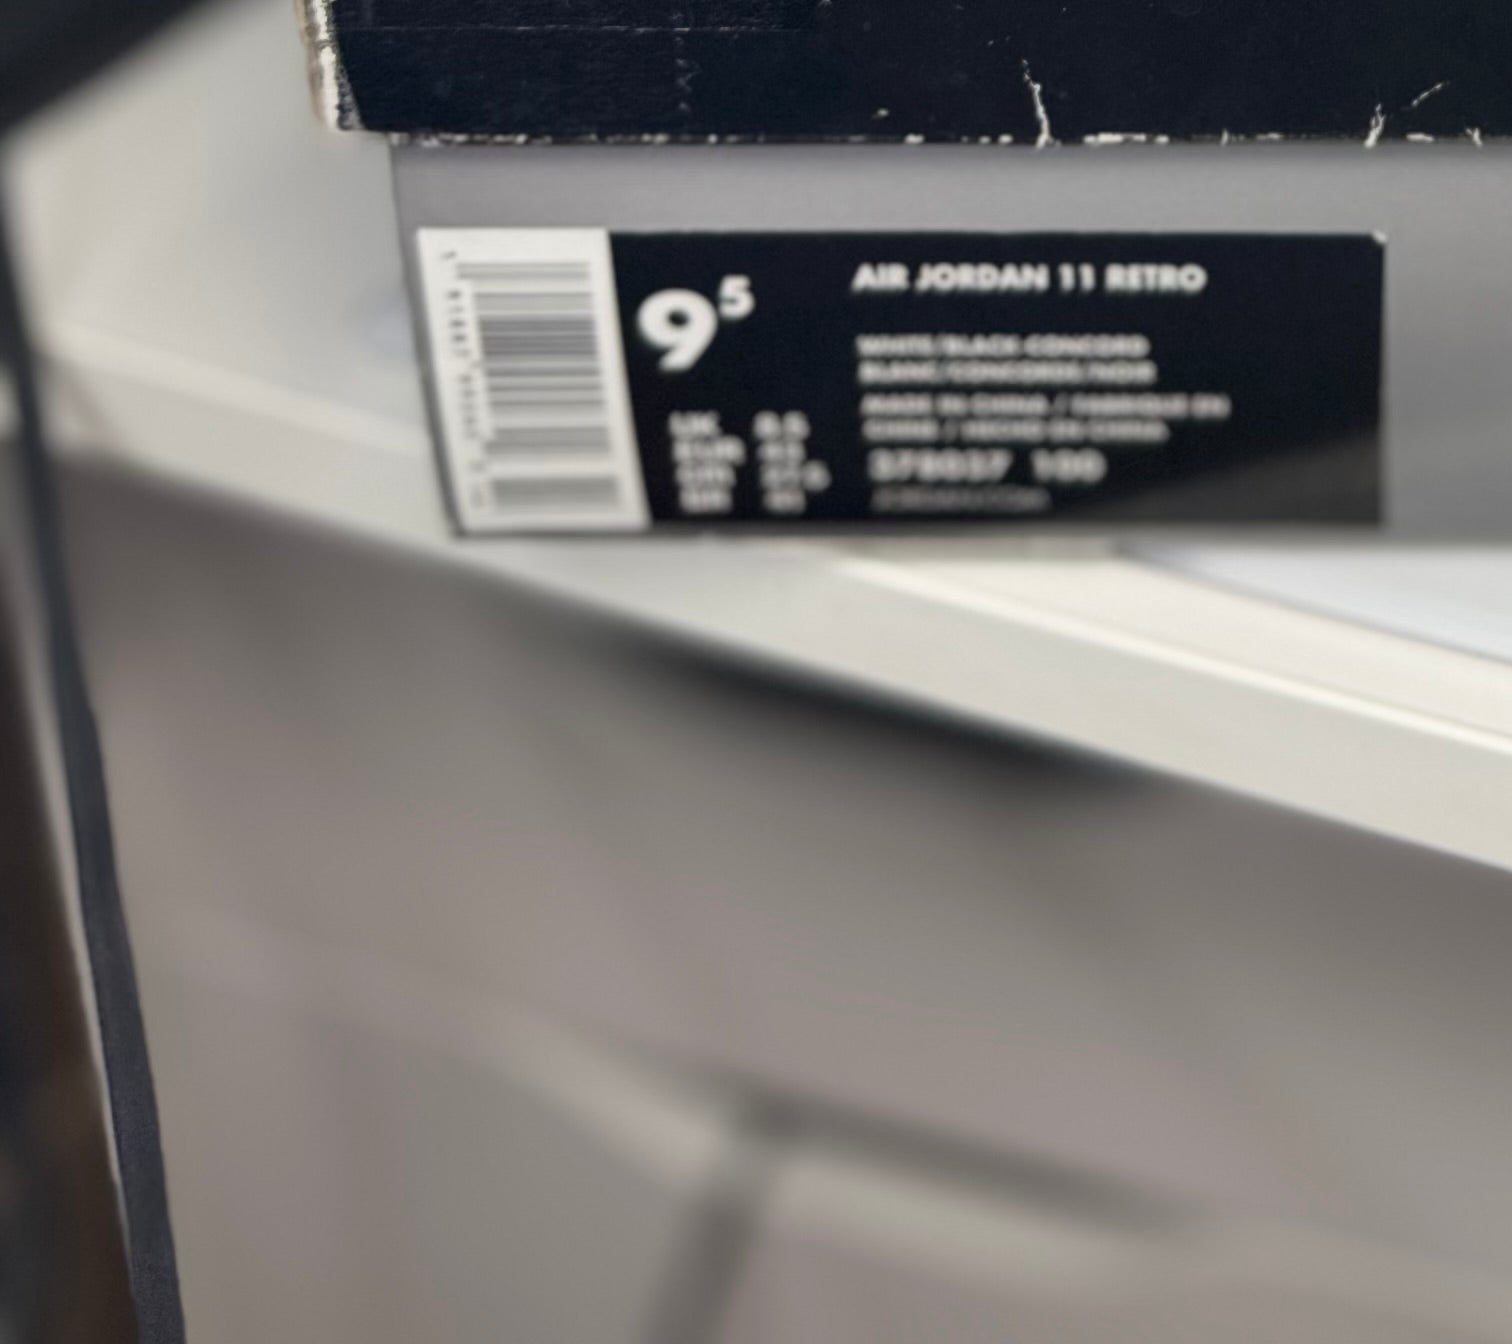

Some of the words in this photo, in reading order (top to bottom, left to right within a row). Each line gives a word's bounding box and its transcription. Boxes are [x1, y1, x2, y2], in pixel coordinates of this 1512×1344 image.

[852, 263, 909, 292] AIR
[915, 263, 1050, 292] JORDAN
[1058, 263, 1096, 292] 11
[1104, 263, 1207, 293] RETRO
